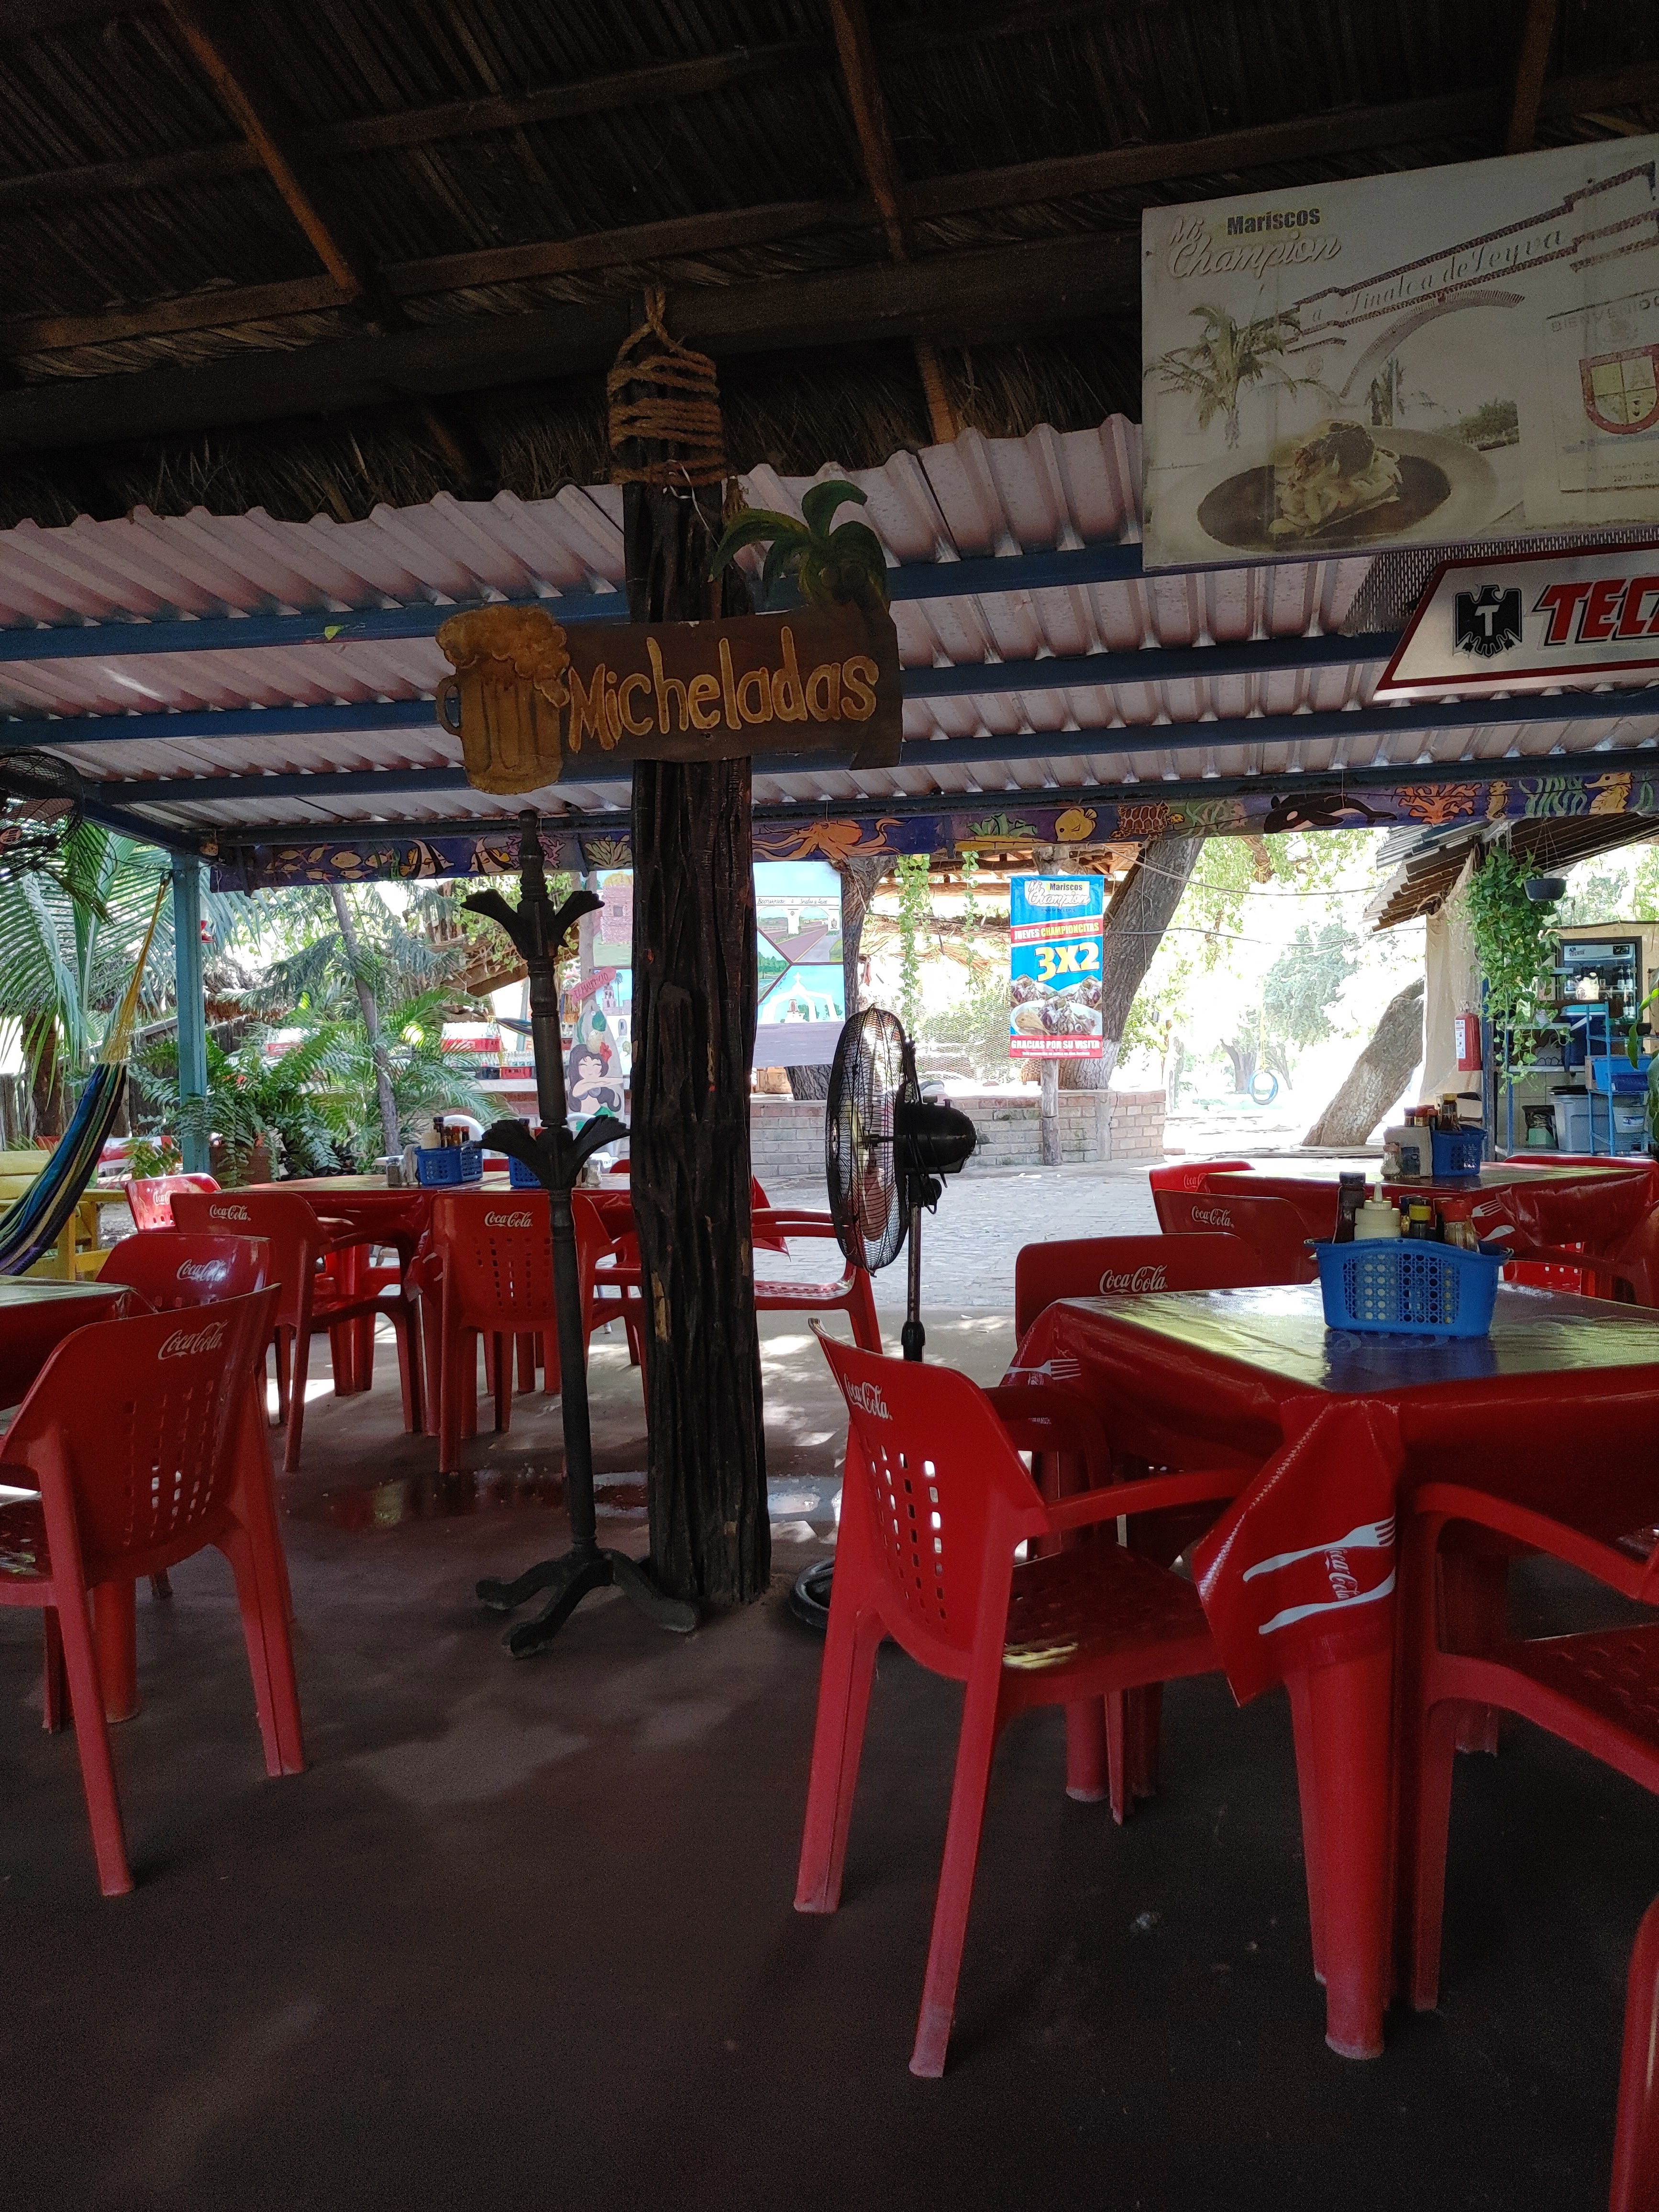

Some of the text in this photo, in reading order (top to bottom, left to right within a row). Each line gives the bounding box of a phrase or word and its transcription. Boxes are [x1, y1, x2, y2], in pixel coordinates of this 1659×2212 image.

[1170, 218, 1205, 245] Mi
[1227, 208, 1321, 235] Mariscos
[1169, 231, 1341, 279] Champion
[1532, 576, 1659, 647] TEC
[568, 625, 879, 753] Micheladas
[1029, 891, 1091, 908] Champion
[1050, 882, 1083, 891] Mariscos
[1014, 928, 1040, 940] JUEVES
[1034, 941, 1100, 983] 3X2
[1011, 1040, 1100, 1049] GRACIAS POR SU VISITA
[209, 1204, 248, 1221] Coca-Cola
[485, 1211, 533, 1228] Coca-Cola
[1191, 1205, 1231, 1227] Coca-Cola
[1100, 1264, 1168, 1294] Coca-Cola
[157, 1319, 229, 1360] Coca-Cola
